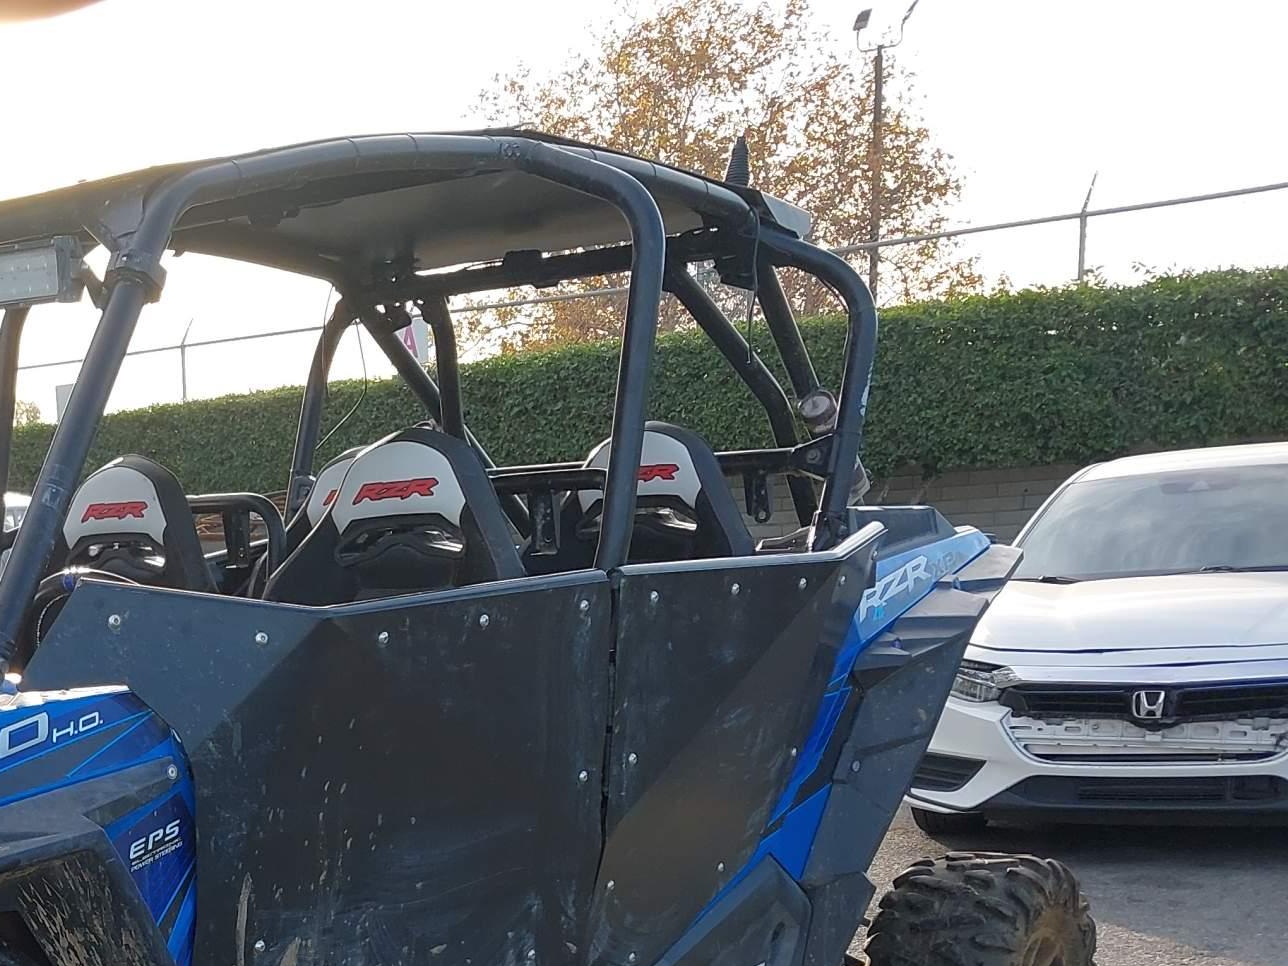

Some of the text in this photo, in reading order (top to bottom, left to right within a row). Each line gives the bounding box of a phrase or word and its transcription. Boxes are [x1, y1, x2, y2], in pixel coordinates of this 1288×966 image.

[353, 477, 439, 505] RZR
[81, 501, 149, 523] RZR
[859, 554, 932, 623] RZR
[52, 711, 104, 743] H.O.
[129, 819, 181, 859] EPS
